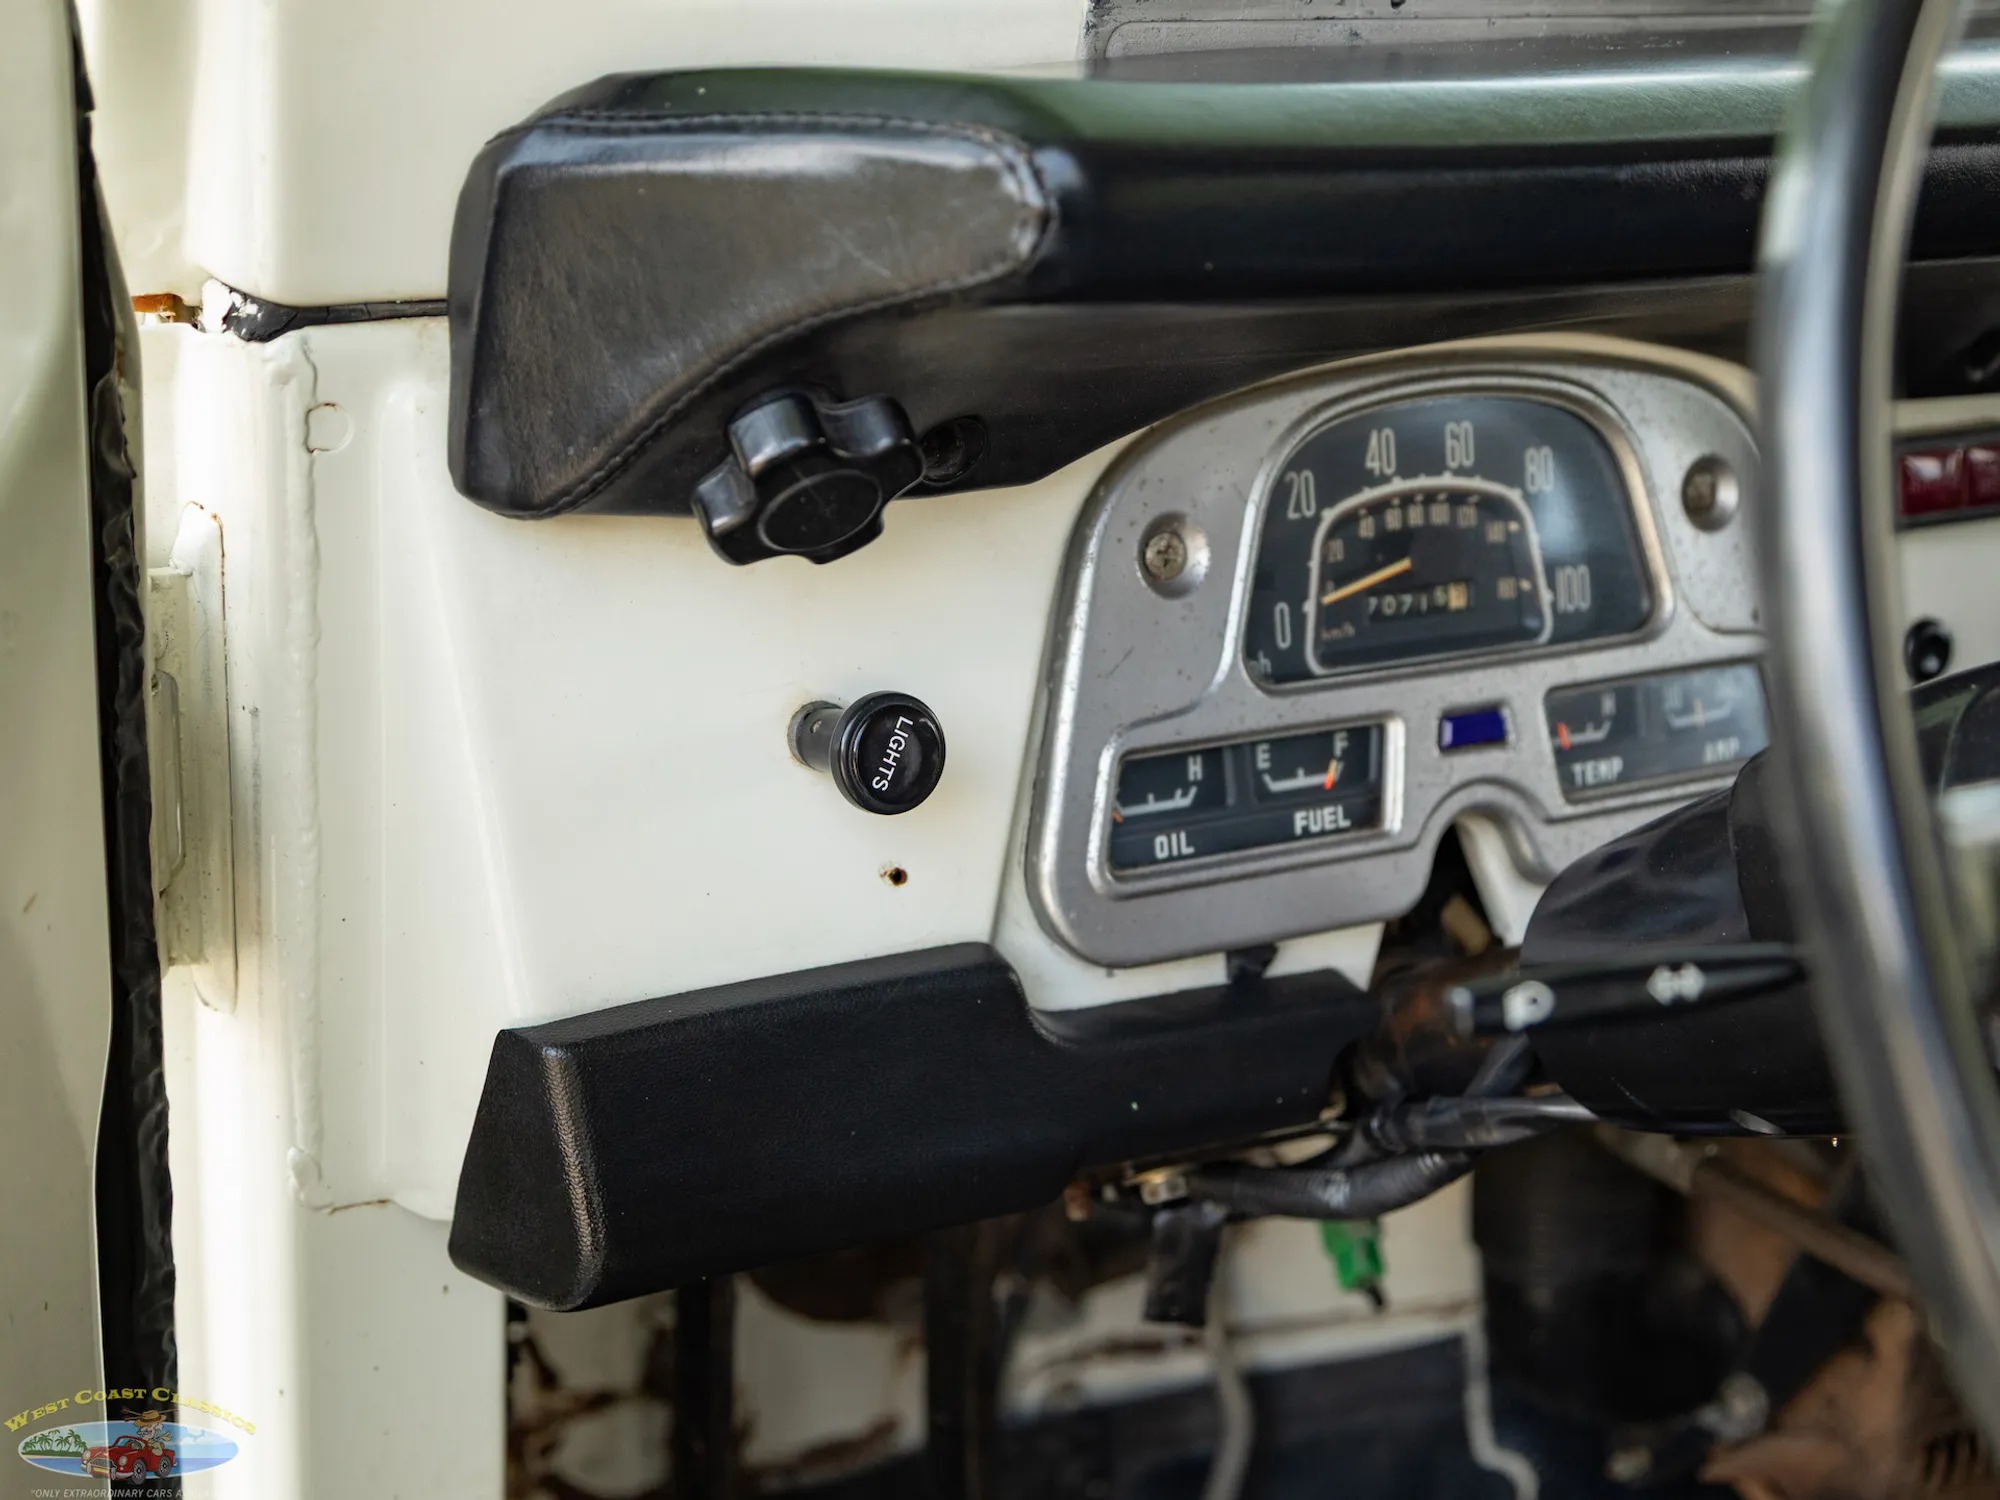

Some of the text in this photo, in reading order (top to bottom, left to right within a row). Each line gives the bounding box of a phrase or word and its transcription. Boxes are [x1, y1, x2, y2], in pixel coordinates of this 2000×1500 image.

[1365, 428, 1396, 476] 40
[1445, 421, 1474, 468] 60
[1525, 446, 1553, 494] 80
[1285, 469, 1316, 520] 20
[1555, 565, 1591, 613] 100
[1274, 601, 1291, 650] 0
[872, 716, 913, 791] LIGHTS
[1188, 755, 1203, 781] H
[1256, 744, 1271, 769] E
[1334, 732, 1348, 757] F
[1571, 756, 1623, 787] TEMP
[1293, 805, 1351, 836] FUEL
[1154, 831, 1194, 859] OIL
